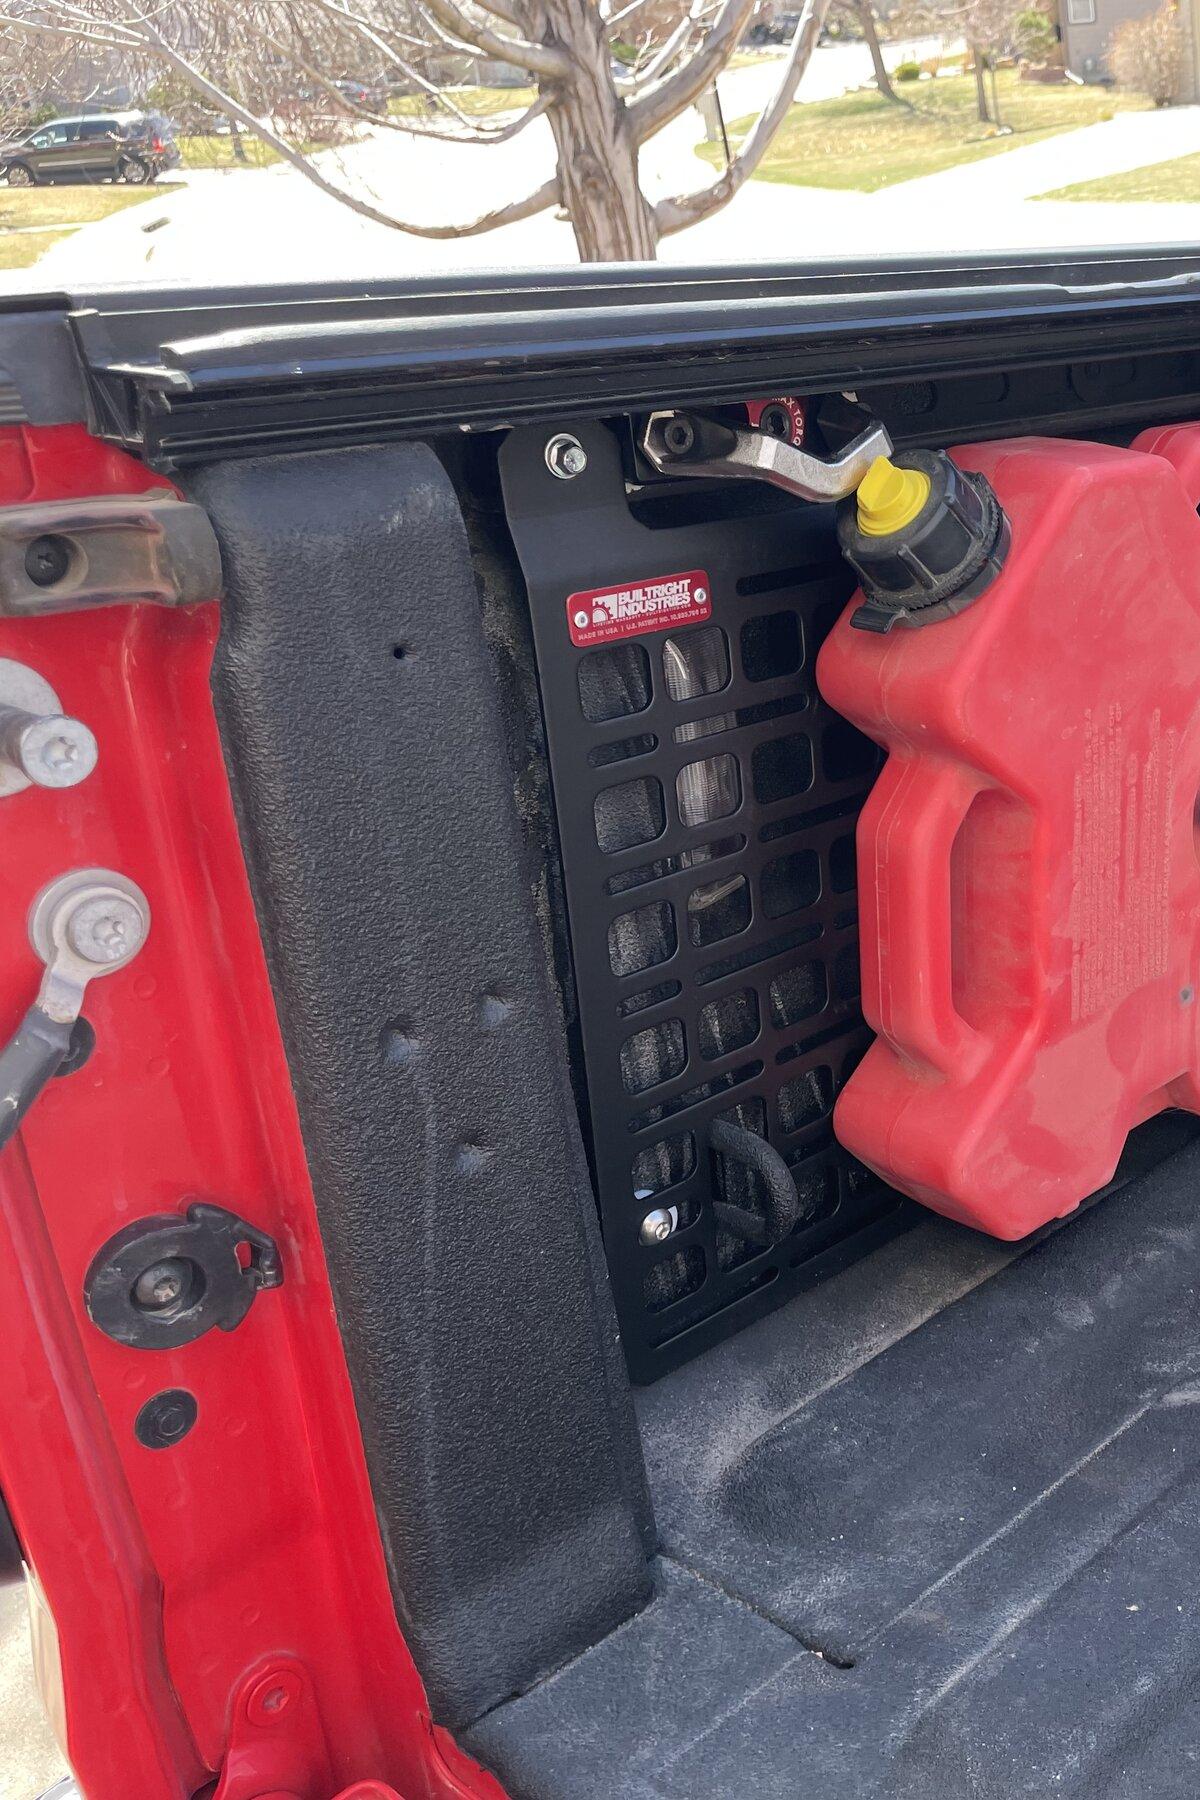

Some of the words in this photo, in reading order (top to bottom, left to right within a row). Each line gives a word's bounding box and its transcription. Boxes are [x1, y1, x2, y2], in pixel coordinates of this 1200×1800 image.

[772, 397, 795, 408] AX
[619, 579, 691, 605] BUILTRIGHT
[619, 592, 691, 619] INDUSTRIES
